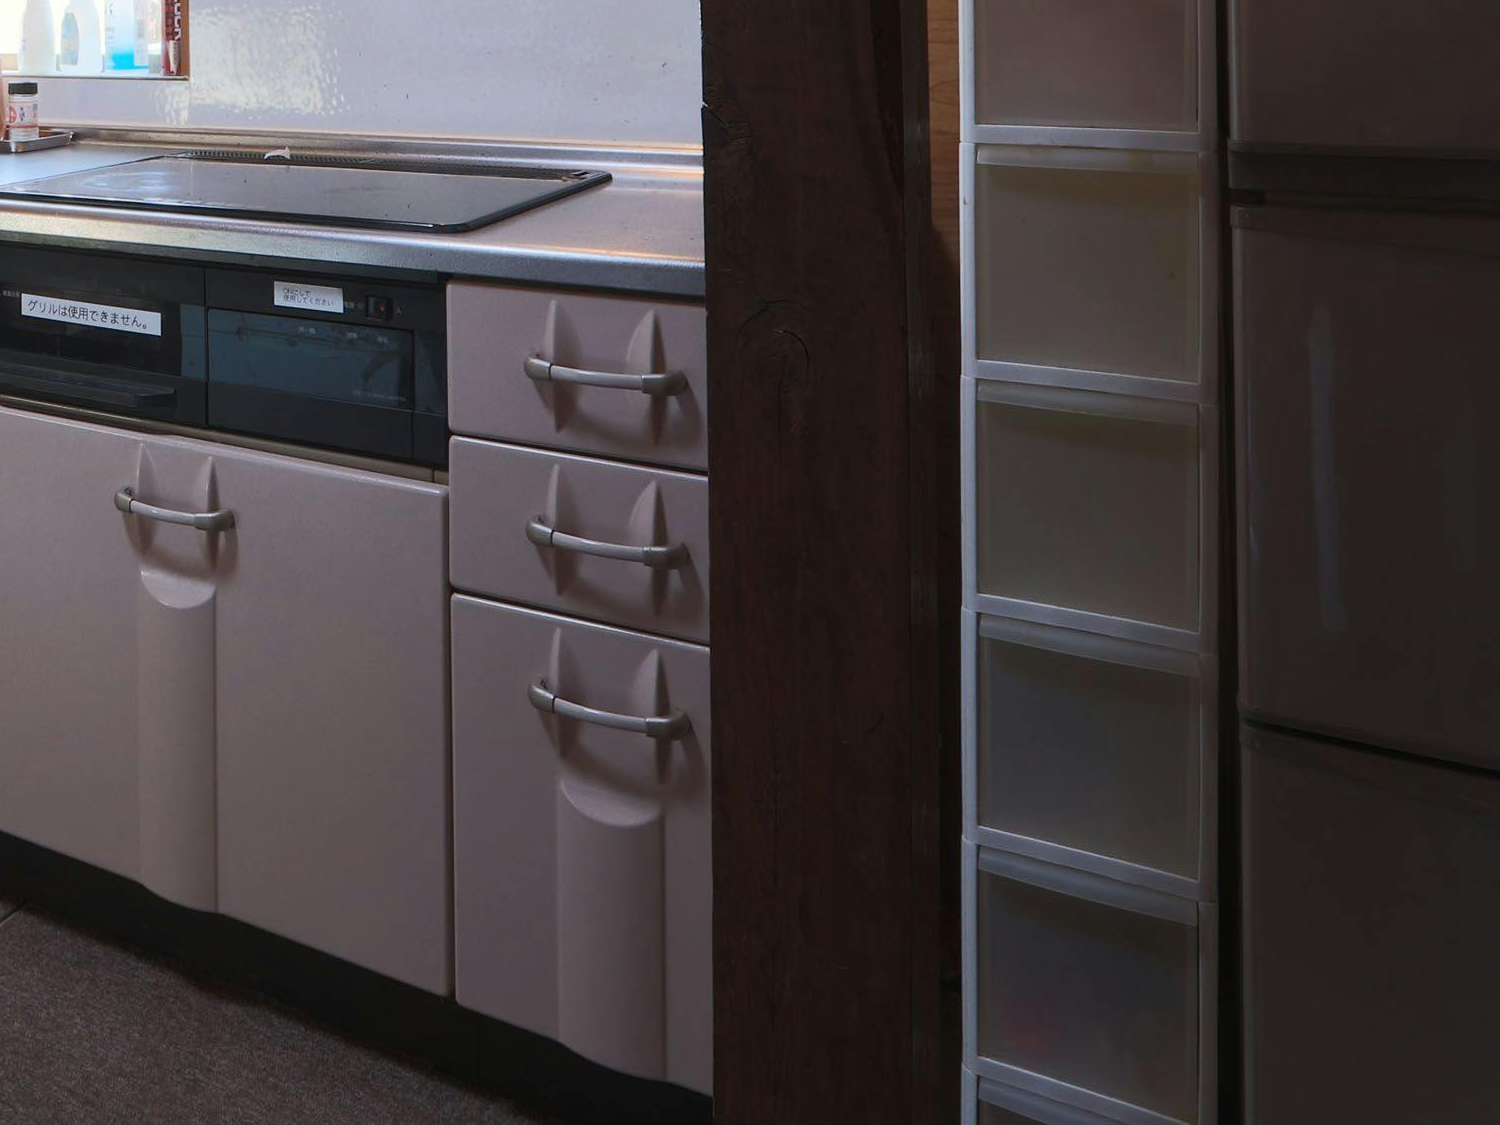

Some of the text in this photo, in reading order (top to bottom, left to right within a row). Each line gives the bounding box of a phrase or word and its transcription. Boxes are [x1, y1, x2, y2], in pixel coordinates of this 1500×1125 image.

[27, 299, 148, 330] グリルは使用できません。
